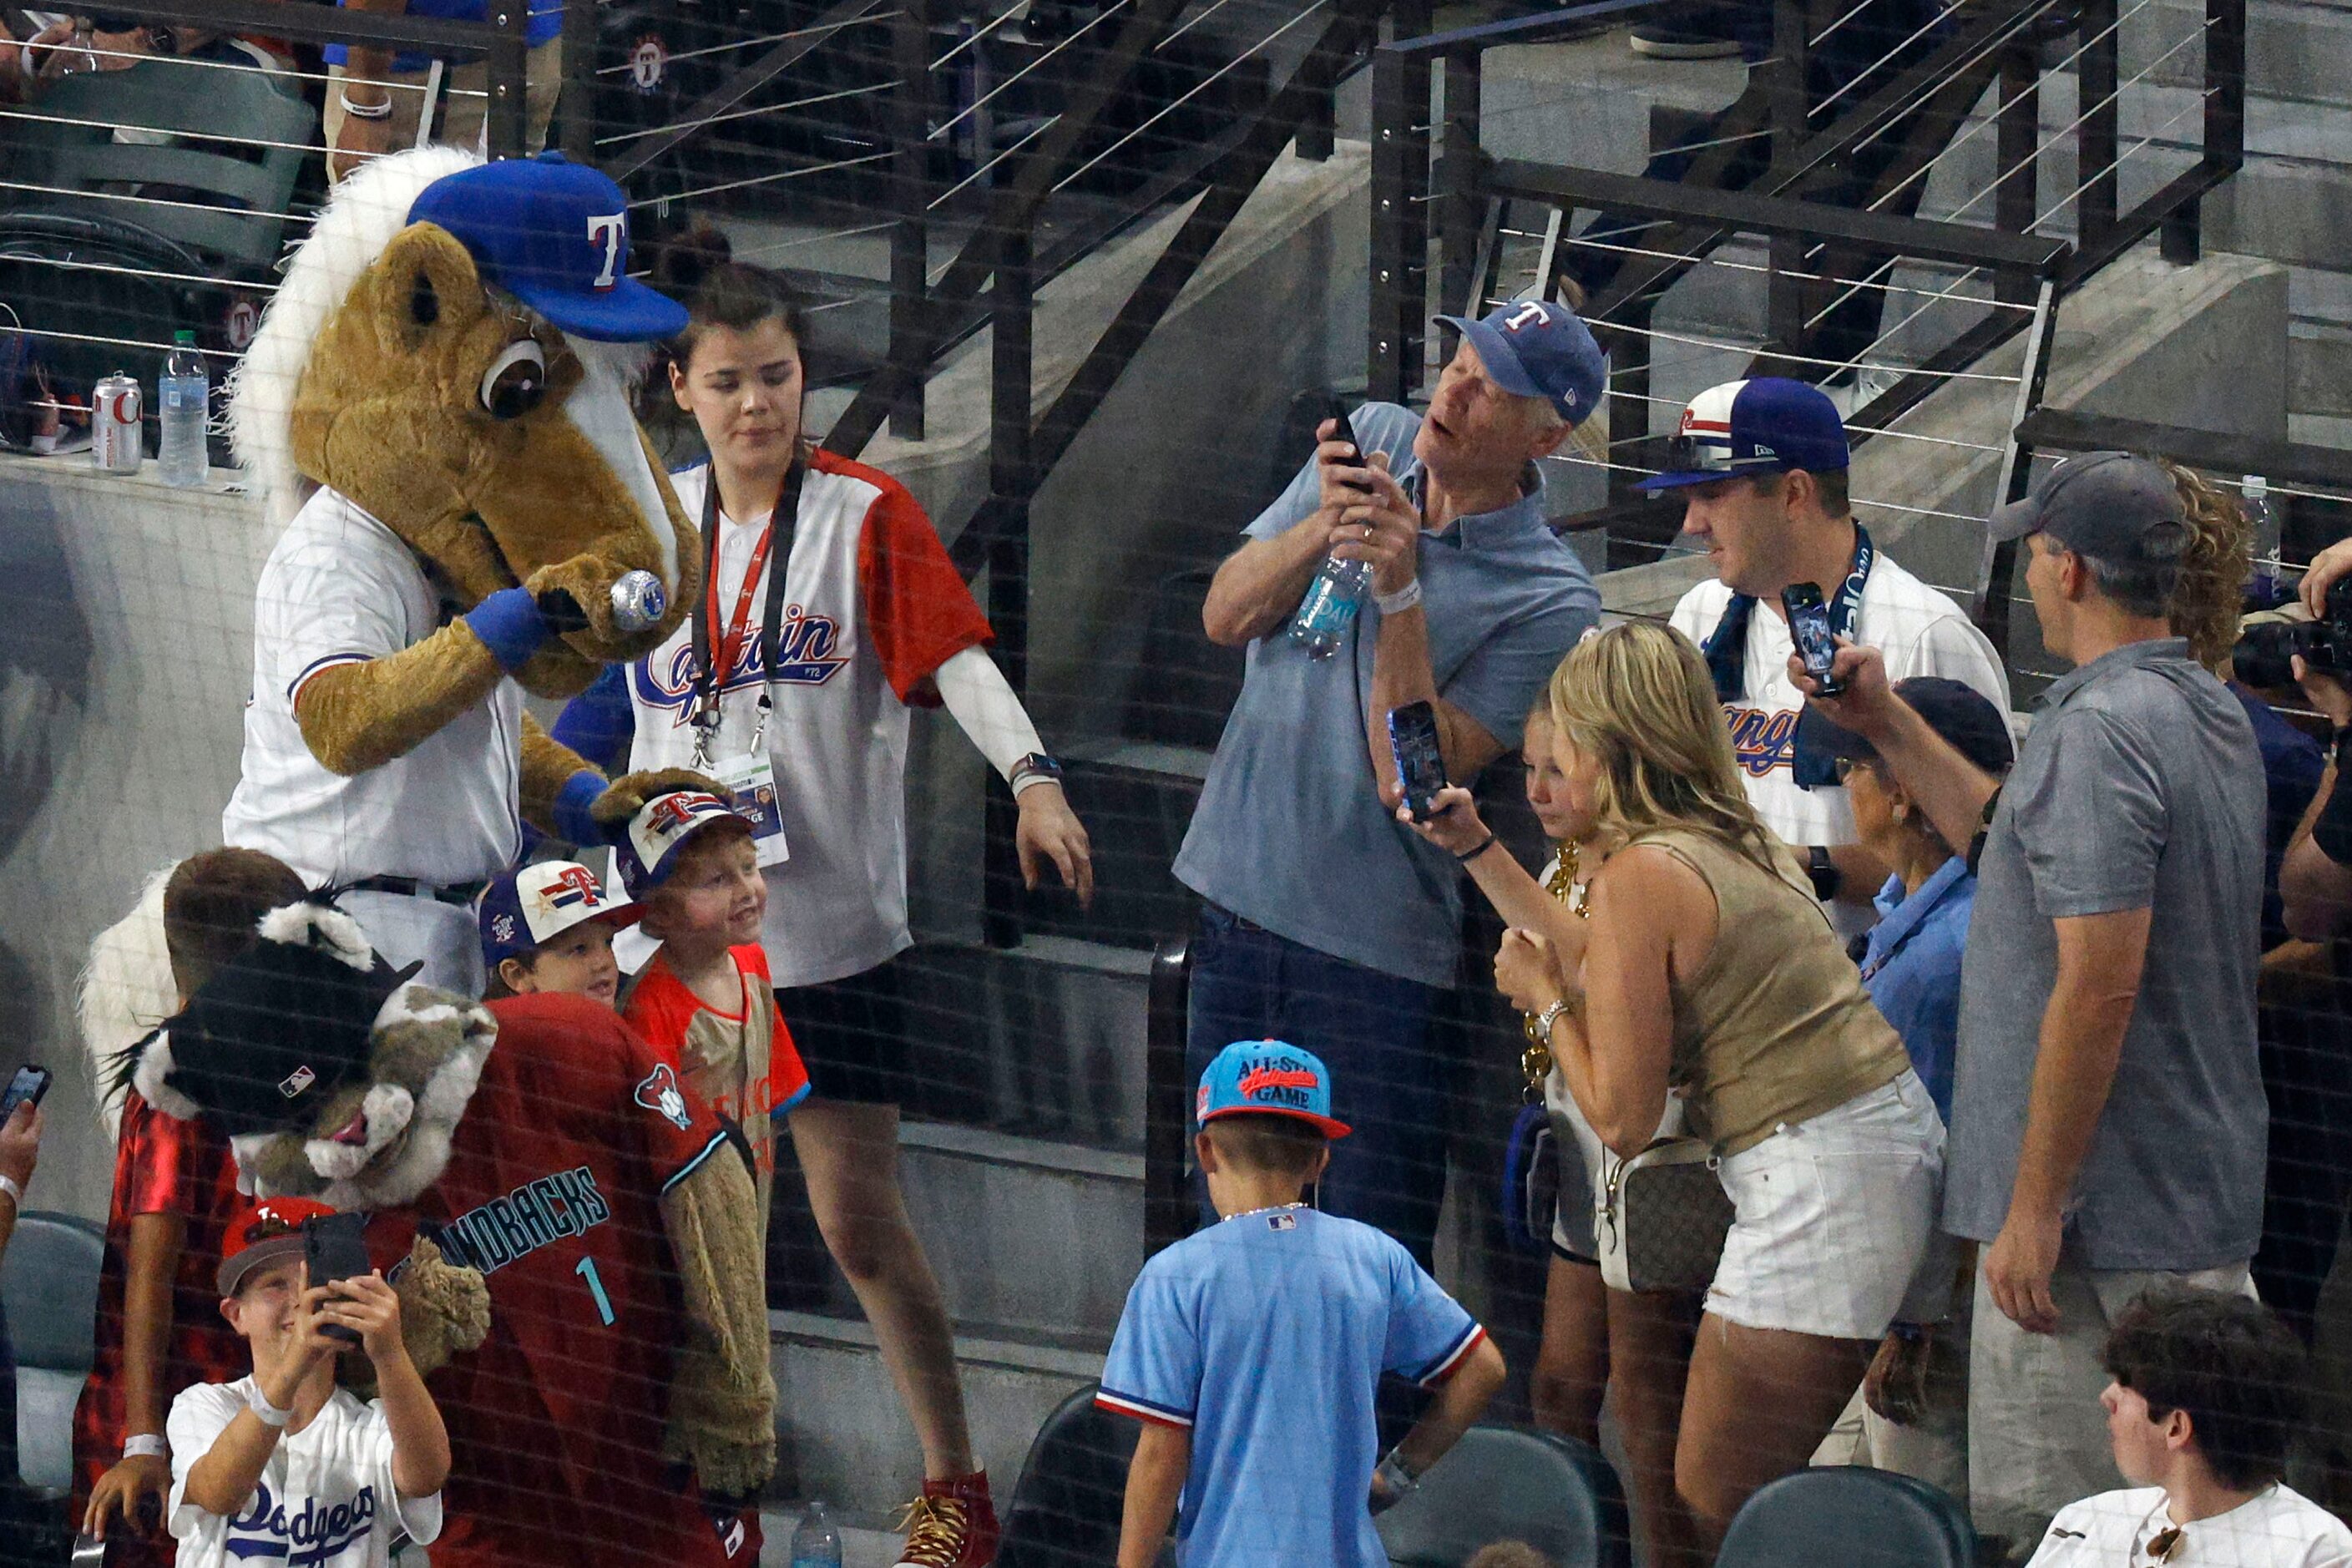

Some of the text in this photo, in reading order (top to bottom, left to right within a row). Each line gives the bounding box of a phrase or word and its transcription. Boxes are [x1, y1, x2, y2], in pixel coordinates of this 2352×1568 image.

[587, 211, 625, 292] T
[1505, 301, 1550, 332] T
[652, 791, 696, 825] T
[559, 866, 600, 907] T
[1257, 1085, 1311, 1110] GAME
[575, 1255, 616, 1327] 1
